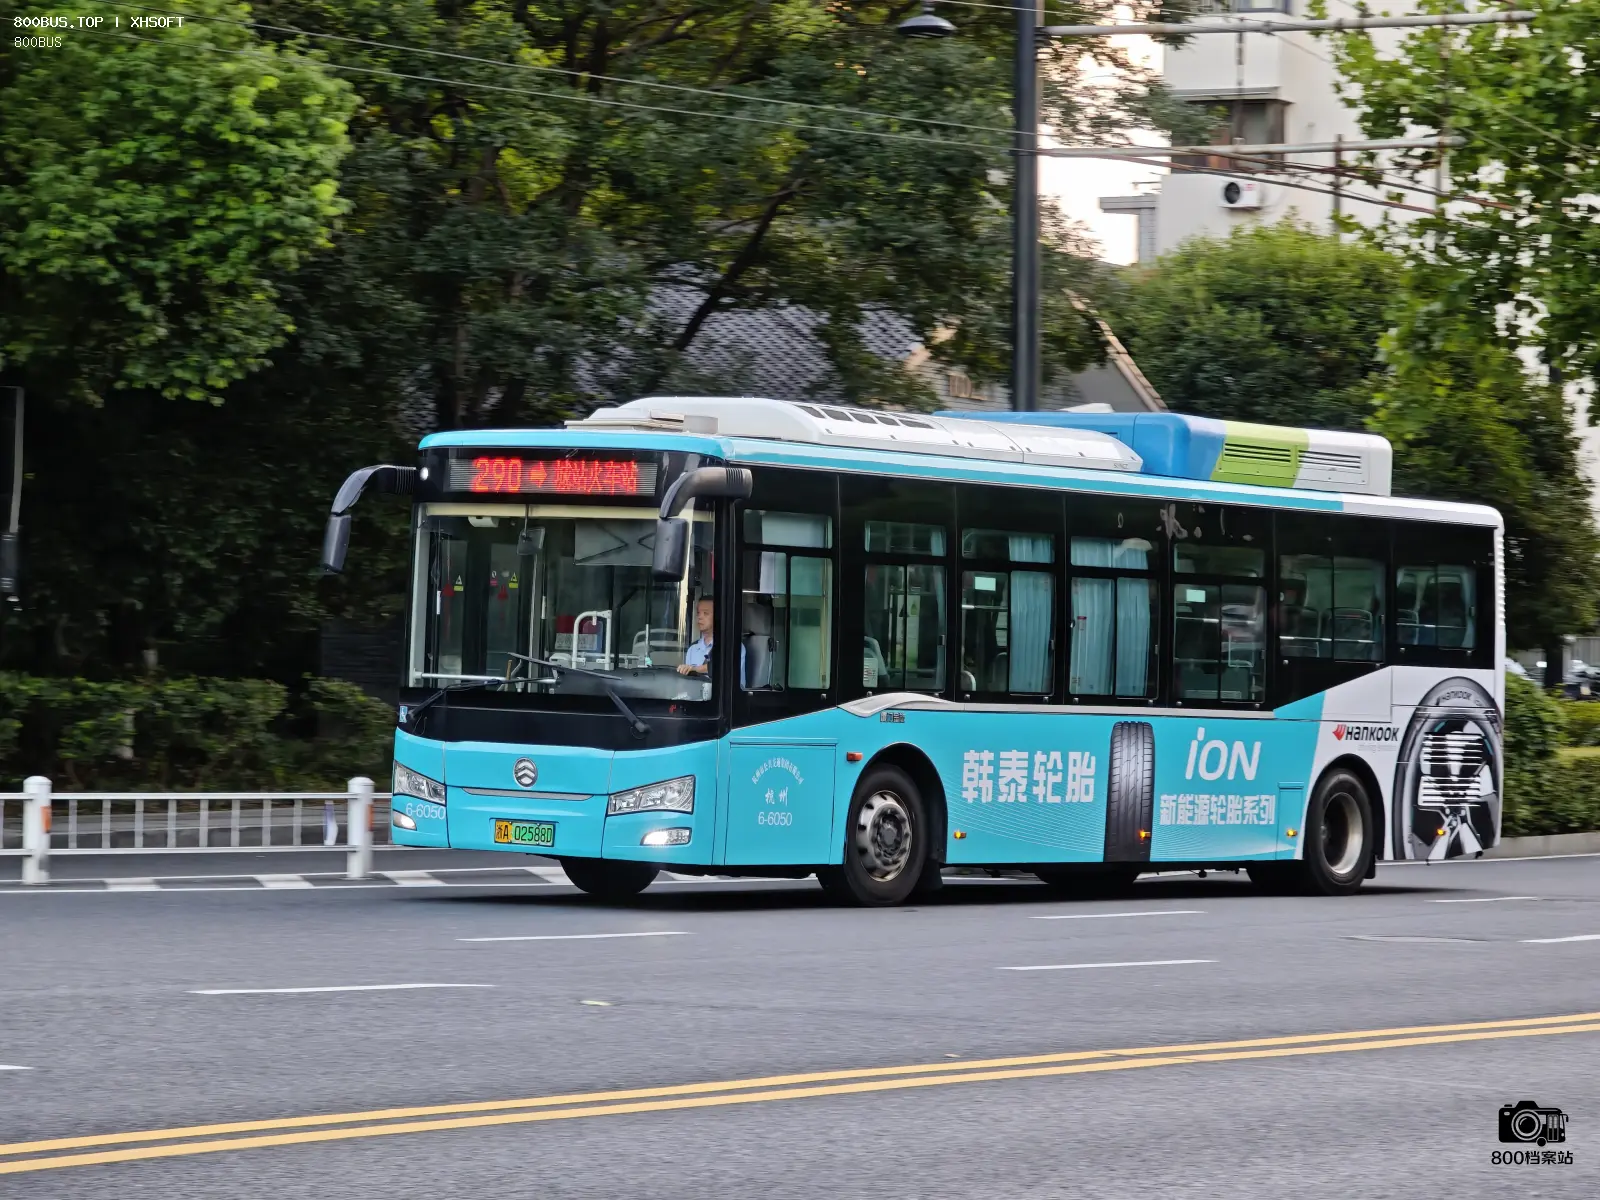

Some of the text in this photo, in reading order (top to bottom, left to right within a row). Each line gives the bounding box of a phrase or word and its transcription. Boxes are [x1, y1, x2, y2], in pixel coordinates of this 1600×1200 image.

[474, 458, 522, 492] 290
[961, 749, 1097, 804] 韩泰轮胎
[405, 802, 446, 820] 6-6050
[757, 811, 793, 827] 6-6050
[1159, 794, 1276, 825] 新能源轮胎系列
[514, 825, 553, 843] 02588D
